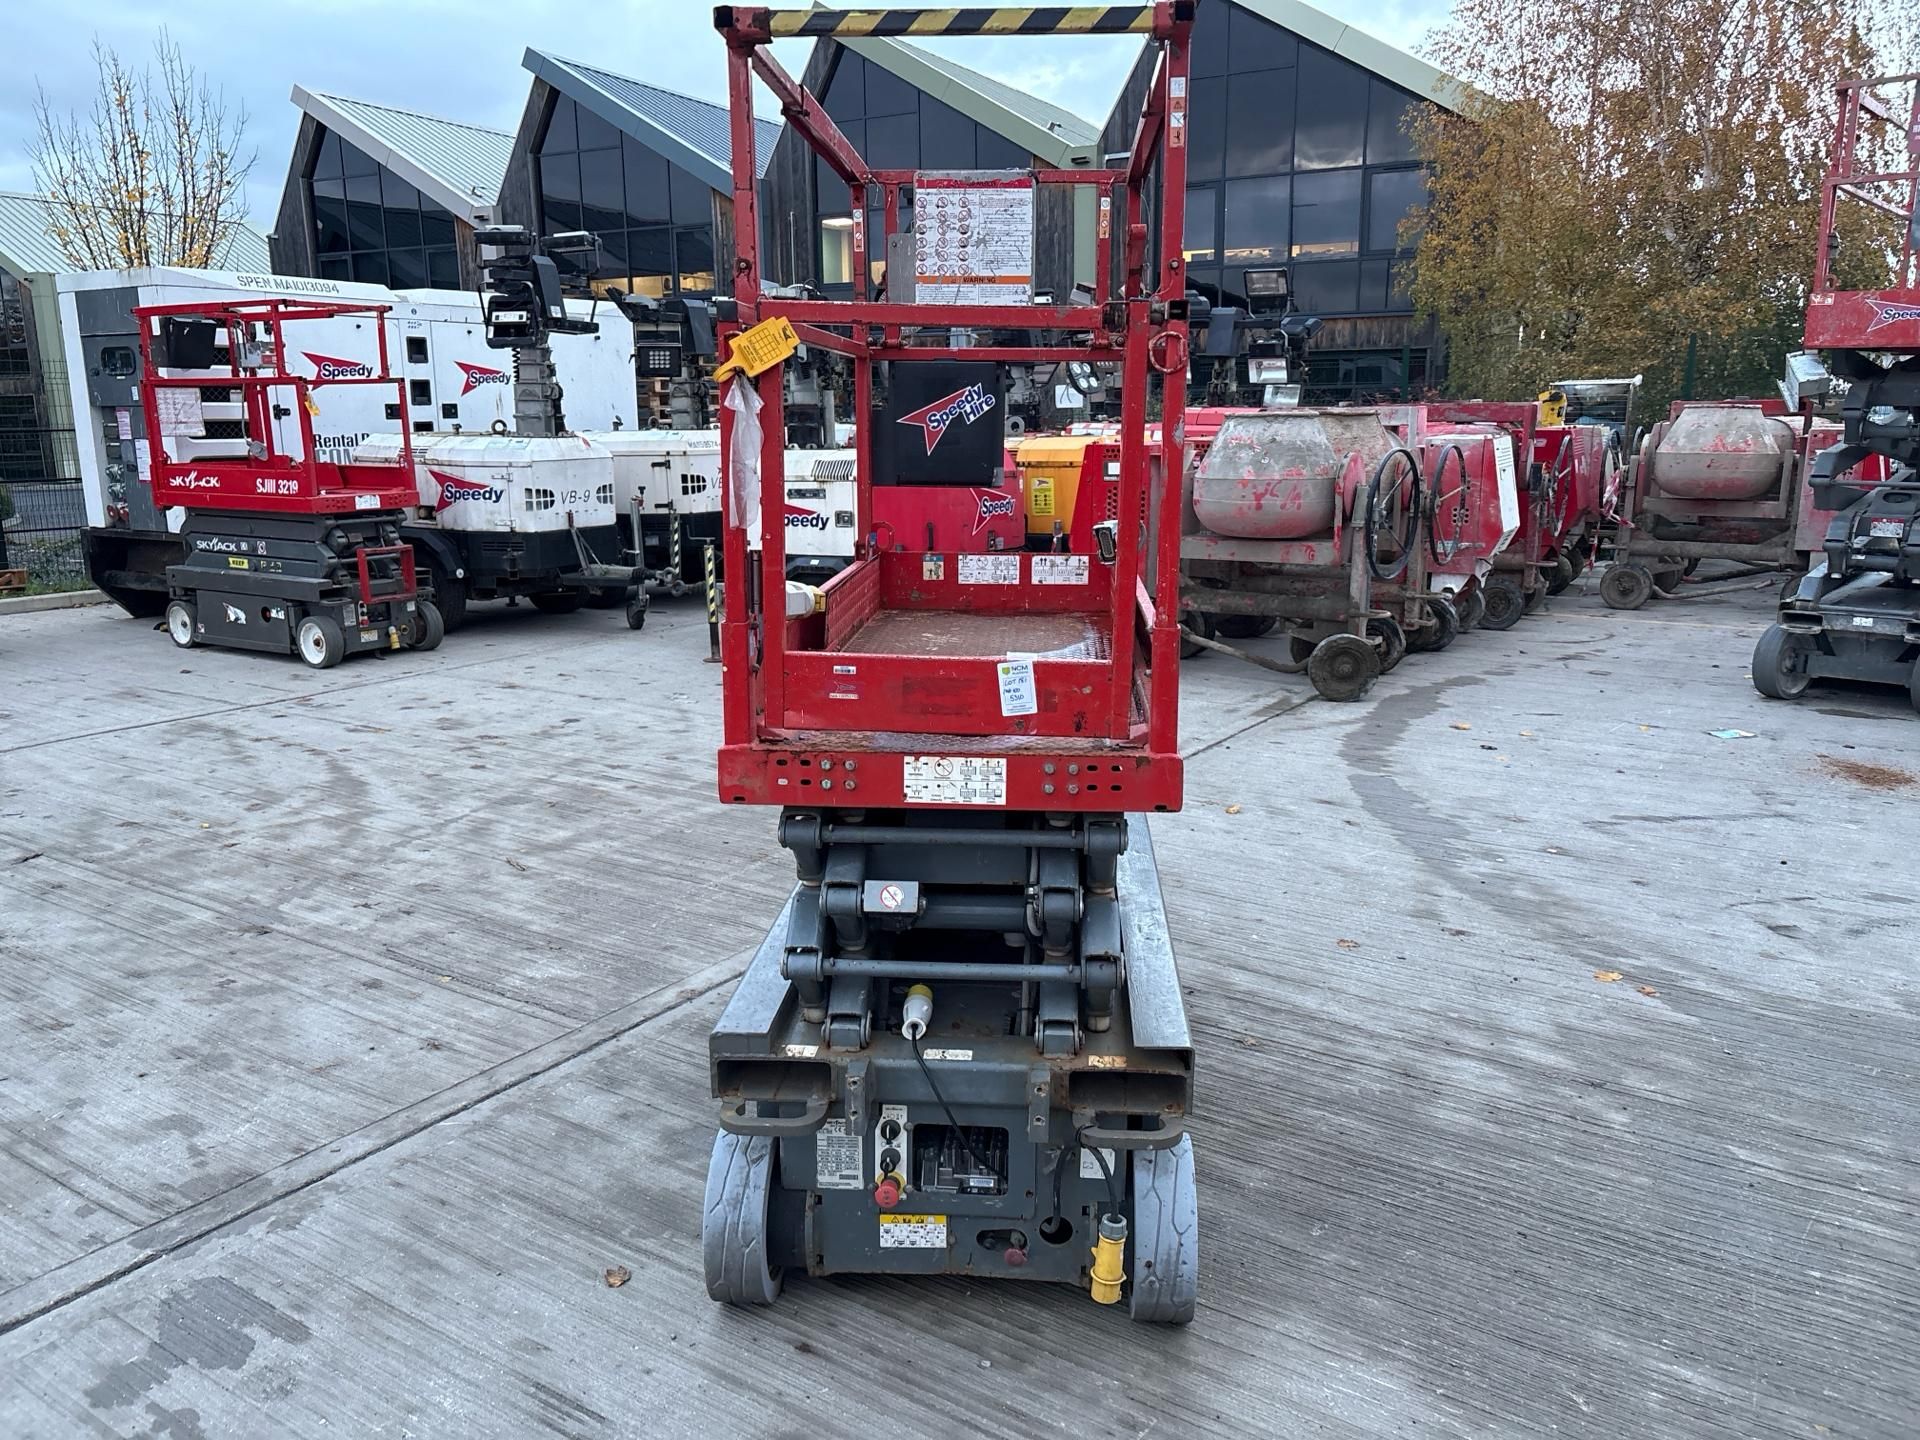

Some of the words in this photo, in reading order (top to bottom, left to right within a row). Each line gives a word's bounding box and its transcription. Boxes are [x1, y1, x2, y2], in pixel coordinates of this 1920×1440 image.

[237, 275, 272, 289] SPEN
[321, 362, 373, 379] Speedy
[469, 370, 512, 386] Speedy
[927, 385, 982, 430] Speedy
[964, 396, 995, 423] Hire
[313, 432, 358, 449] Rental
[278, 479, 299, 495] 3219
[445, 483, 505, 503] Speedy
[560, 489, 591, 505] VB-9
[981, 496, 1015, 517] Speedy
[784, 513, 830, 531] peedy
[196, 537, 237, 552] SKYJACK
